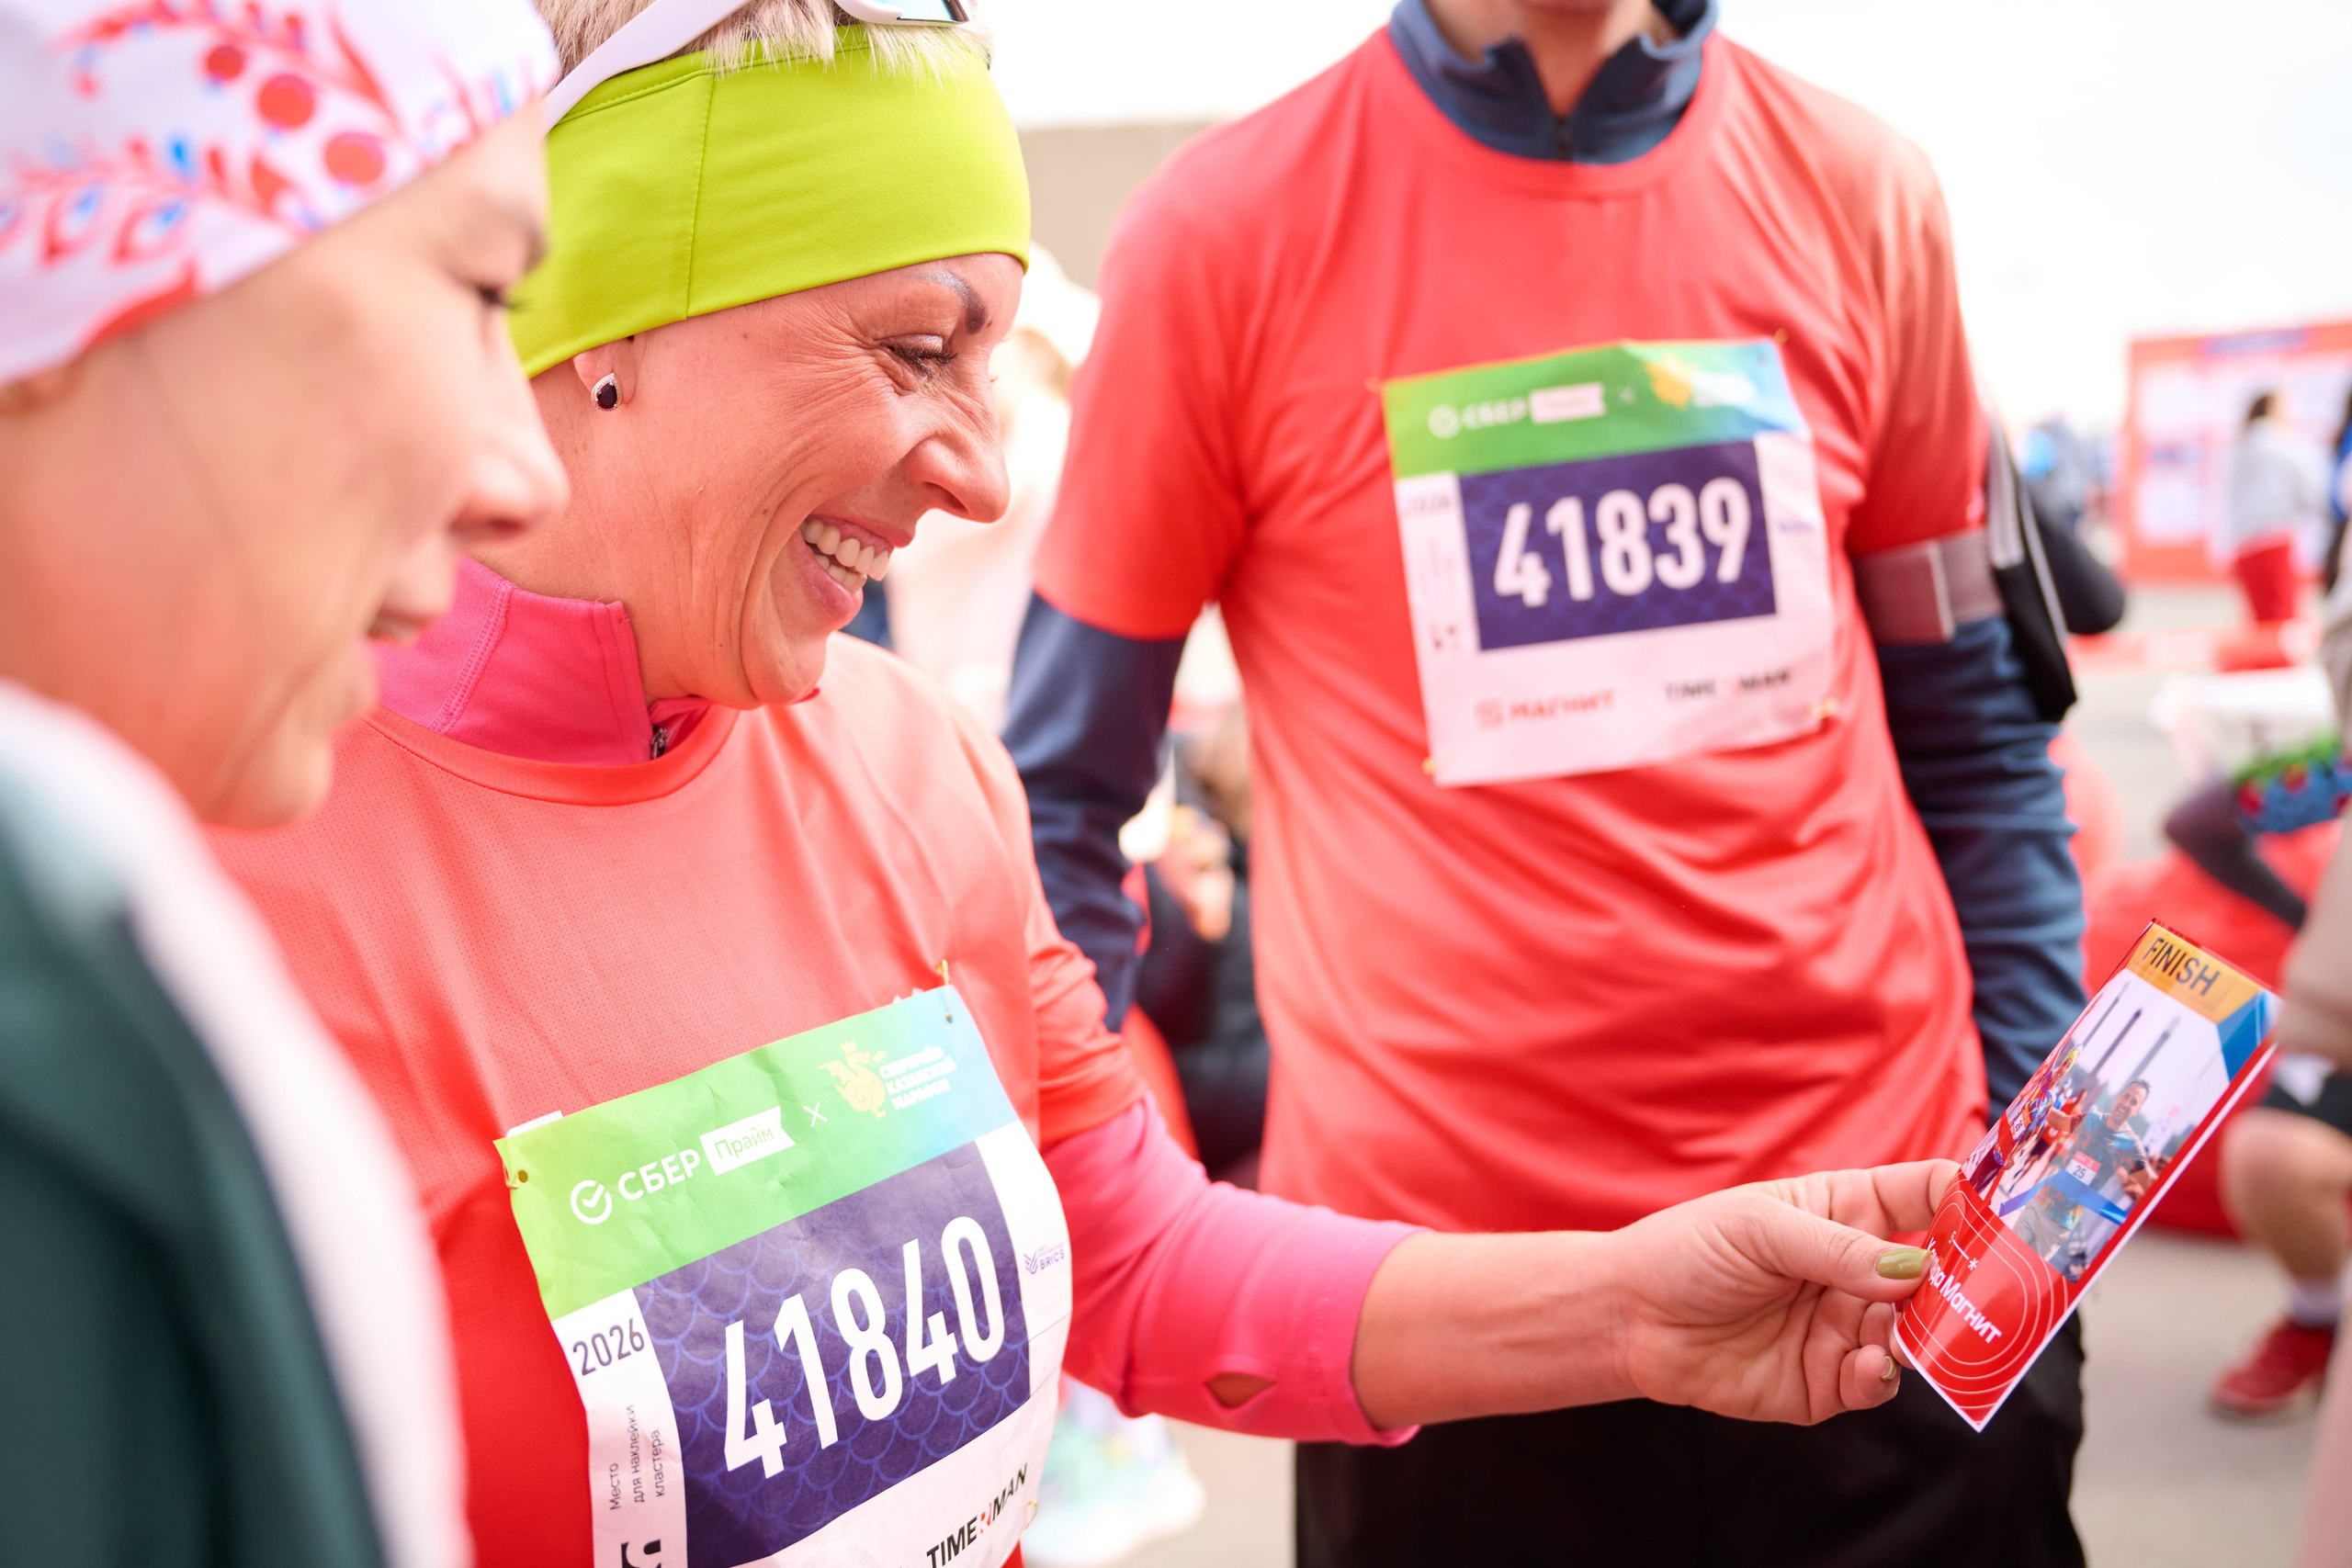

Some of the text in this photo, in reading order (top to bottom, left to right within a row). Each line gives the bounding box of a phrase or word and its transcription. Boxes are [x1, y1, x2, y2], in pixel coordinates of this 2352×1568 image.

[1494, 476, 1751, 607] 41839
[2142, 937, 2221, 997] FINISH
[617, 1126, 775, 1201] СБЕР Прайм
[2072, 1164, 2086, 1179] 25
[1039, 1248, 1065, 1270] BRICS
[1939, 1274, 2002, 1344] Магнит
[572, 1317, 645, 1376] 2026
[724, 1216, 1005, 1479] 41840
[609, 1462, 621, 1510] Место
[626, 1404, 645, 1503] для наклейки
[650, 1429, 665, 1497] кластера
